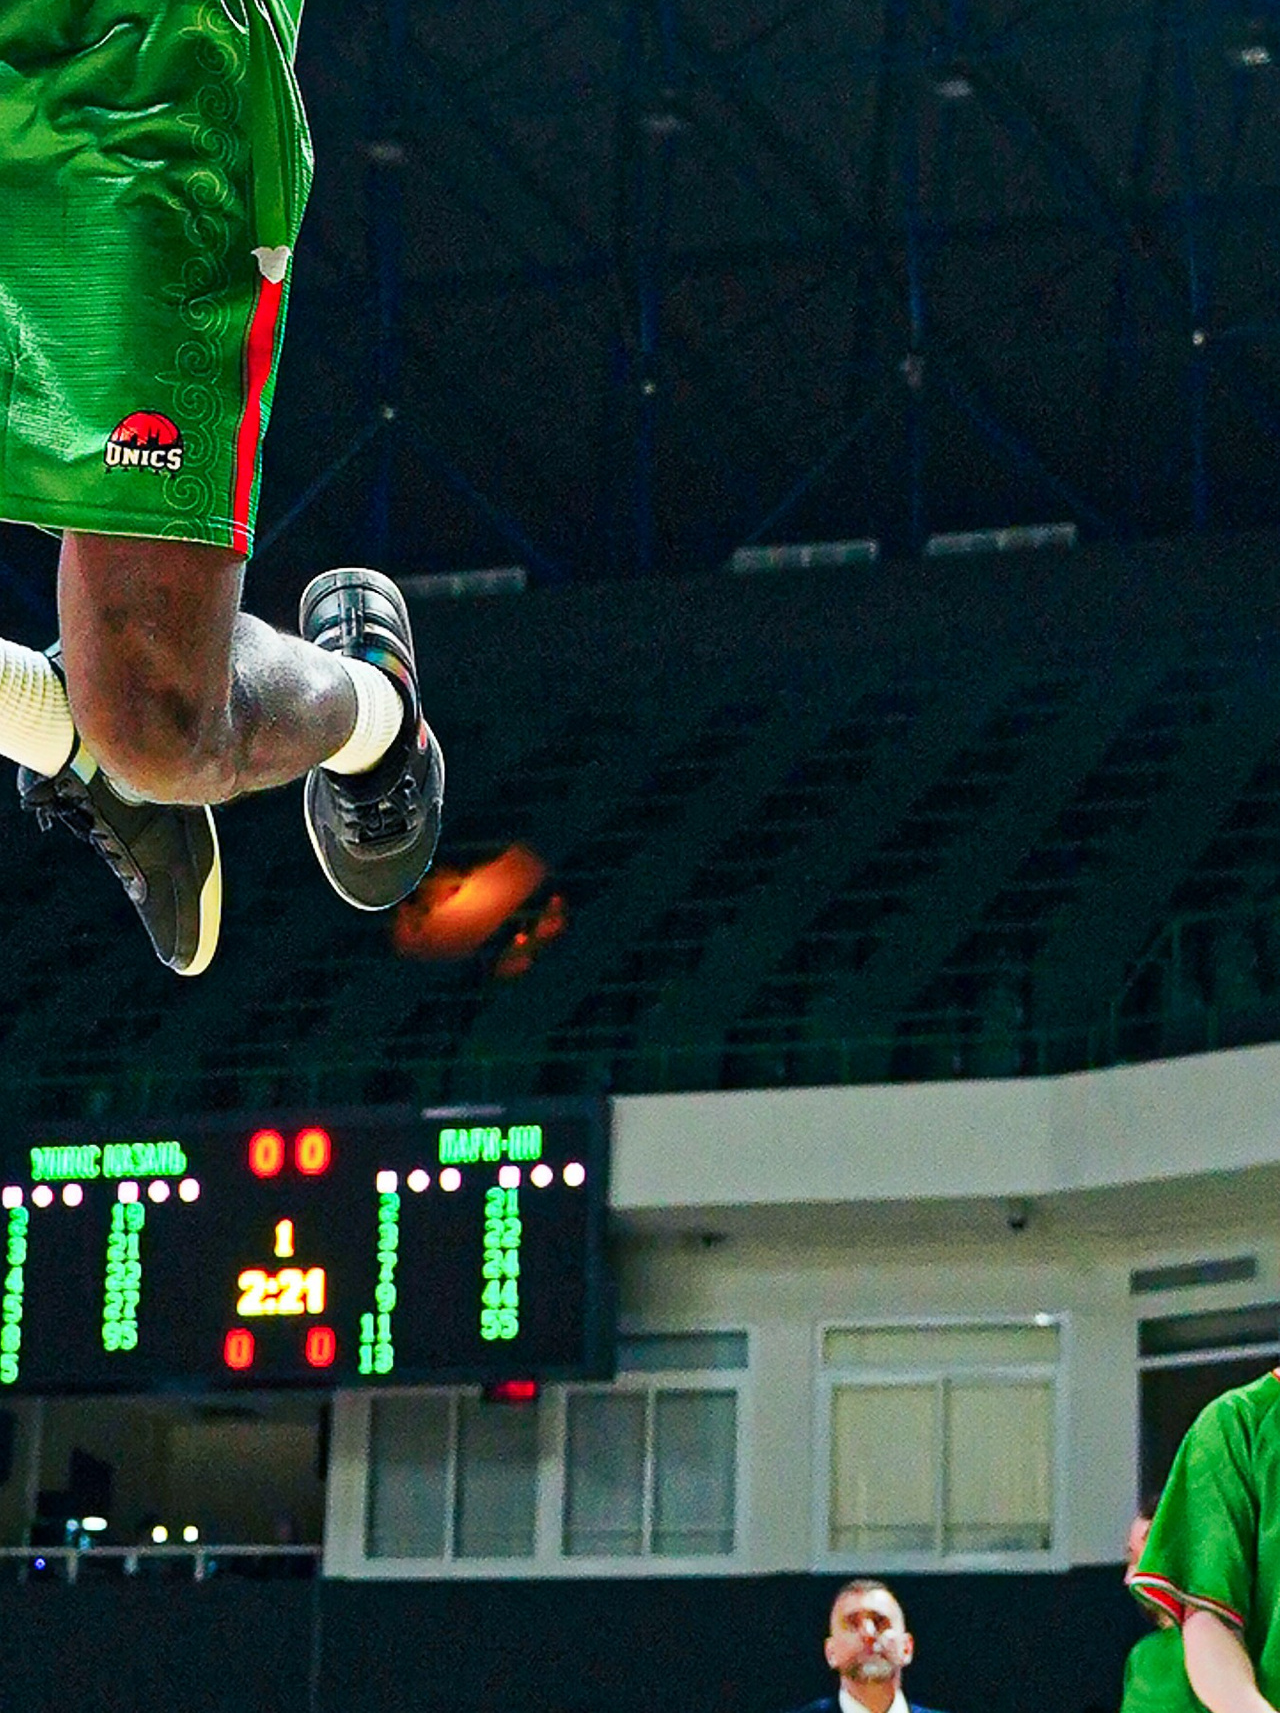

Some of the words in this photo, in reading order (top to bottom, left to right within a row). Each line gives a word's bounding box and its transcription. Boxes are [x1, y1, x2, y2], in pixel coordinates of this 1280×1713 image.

[105, 441, 183, 471] UNICS
[274, 1219, 294, 1258] 1
[4, 1266, 24, 1294] 4
[236, 1267, 326, 1317] 2:21
[2, 1293, 23, 1324] 5
[359, 1312, 392, 1344] 11
[223, 1327, 255, 1372] 0
[305, 1325, 337, 1368] 0
